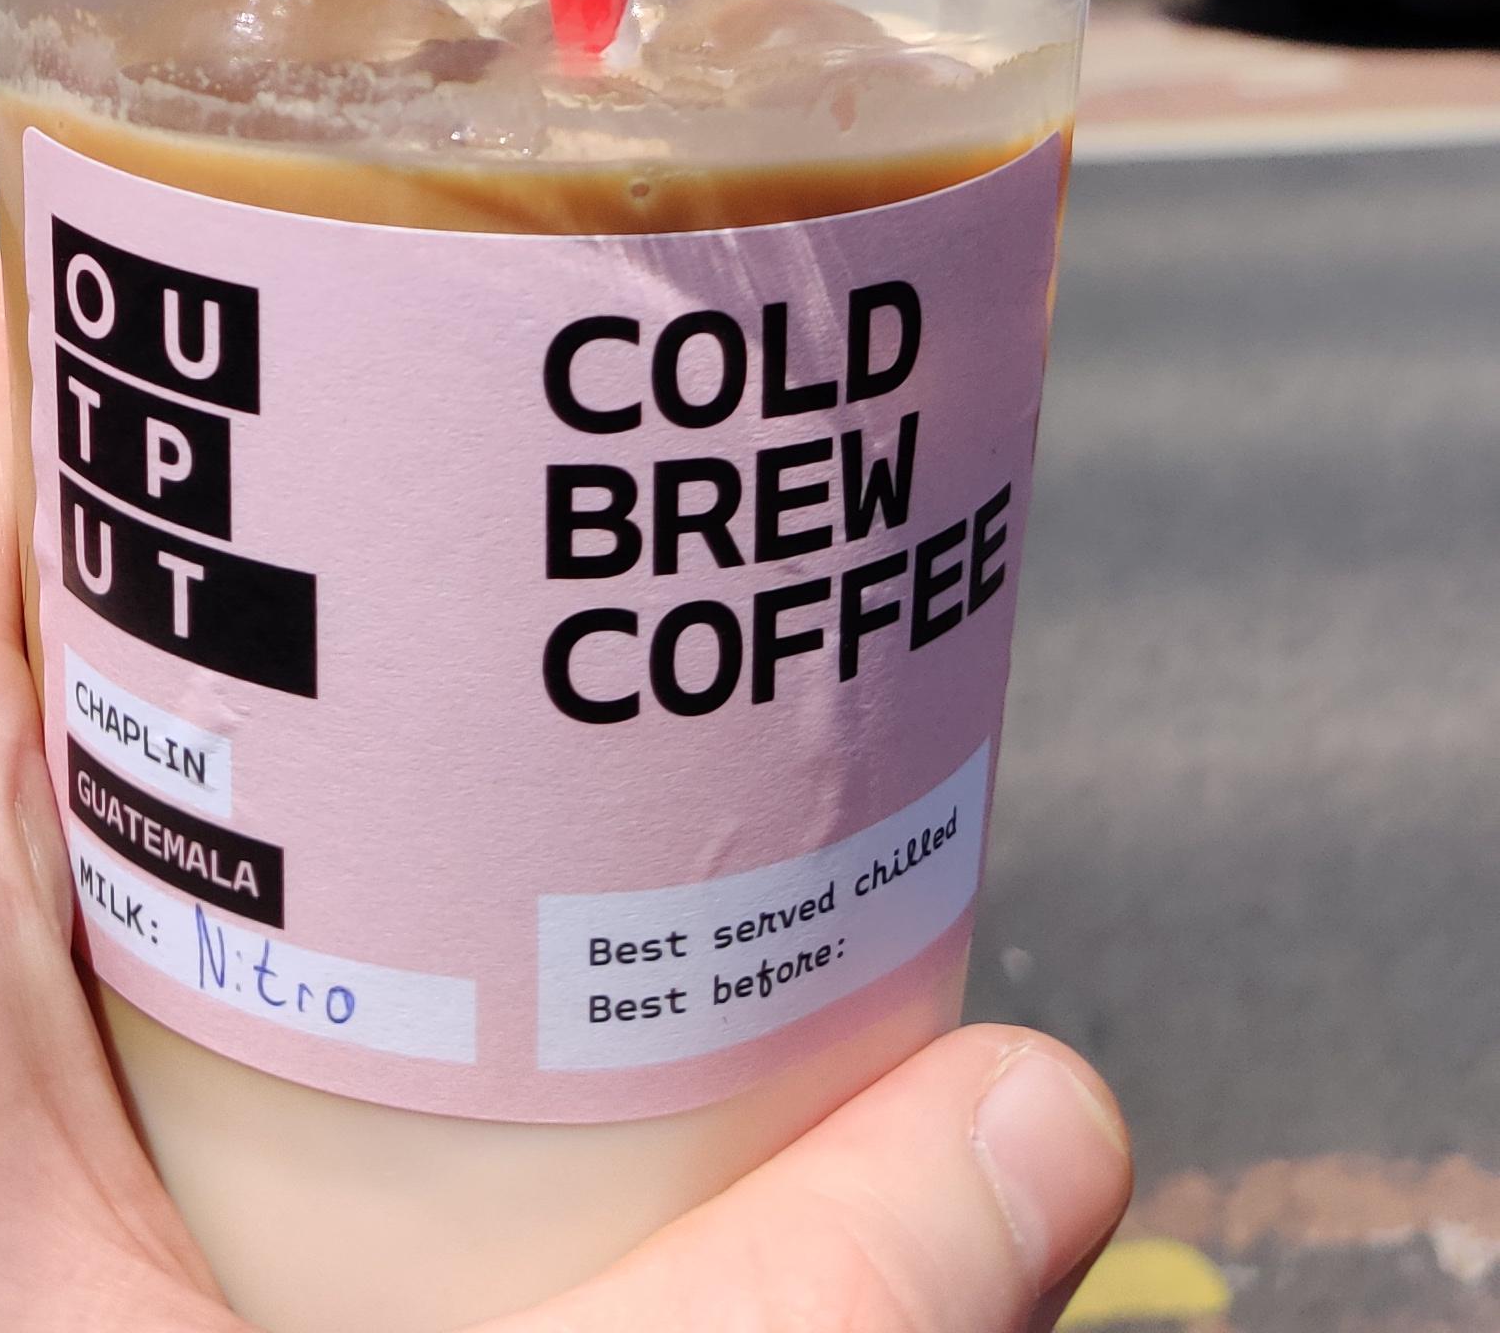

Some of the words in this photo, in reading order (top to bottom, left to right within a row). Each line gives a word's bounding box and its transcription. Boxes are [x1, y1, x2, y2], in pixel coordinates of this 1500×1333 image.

[542, 279, 922, 435] COLD
[545, 409, 920, 580] BREW
[542, 481, 1012, 725] COFFEE
[74, 680, 207, 785] CHAPLIN
[76, 769, 261, 899] GUATEMALA
[79, 856, 159, 945] MILK:
[588, 931, 688, 967] Best
[713, 881, 836, 950] served
[854, 806, 958, 898] chilled
[588, 987, 688, 1024] Best
[713, 937, 846, 1006] before:
